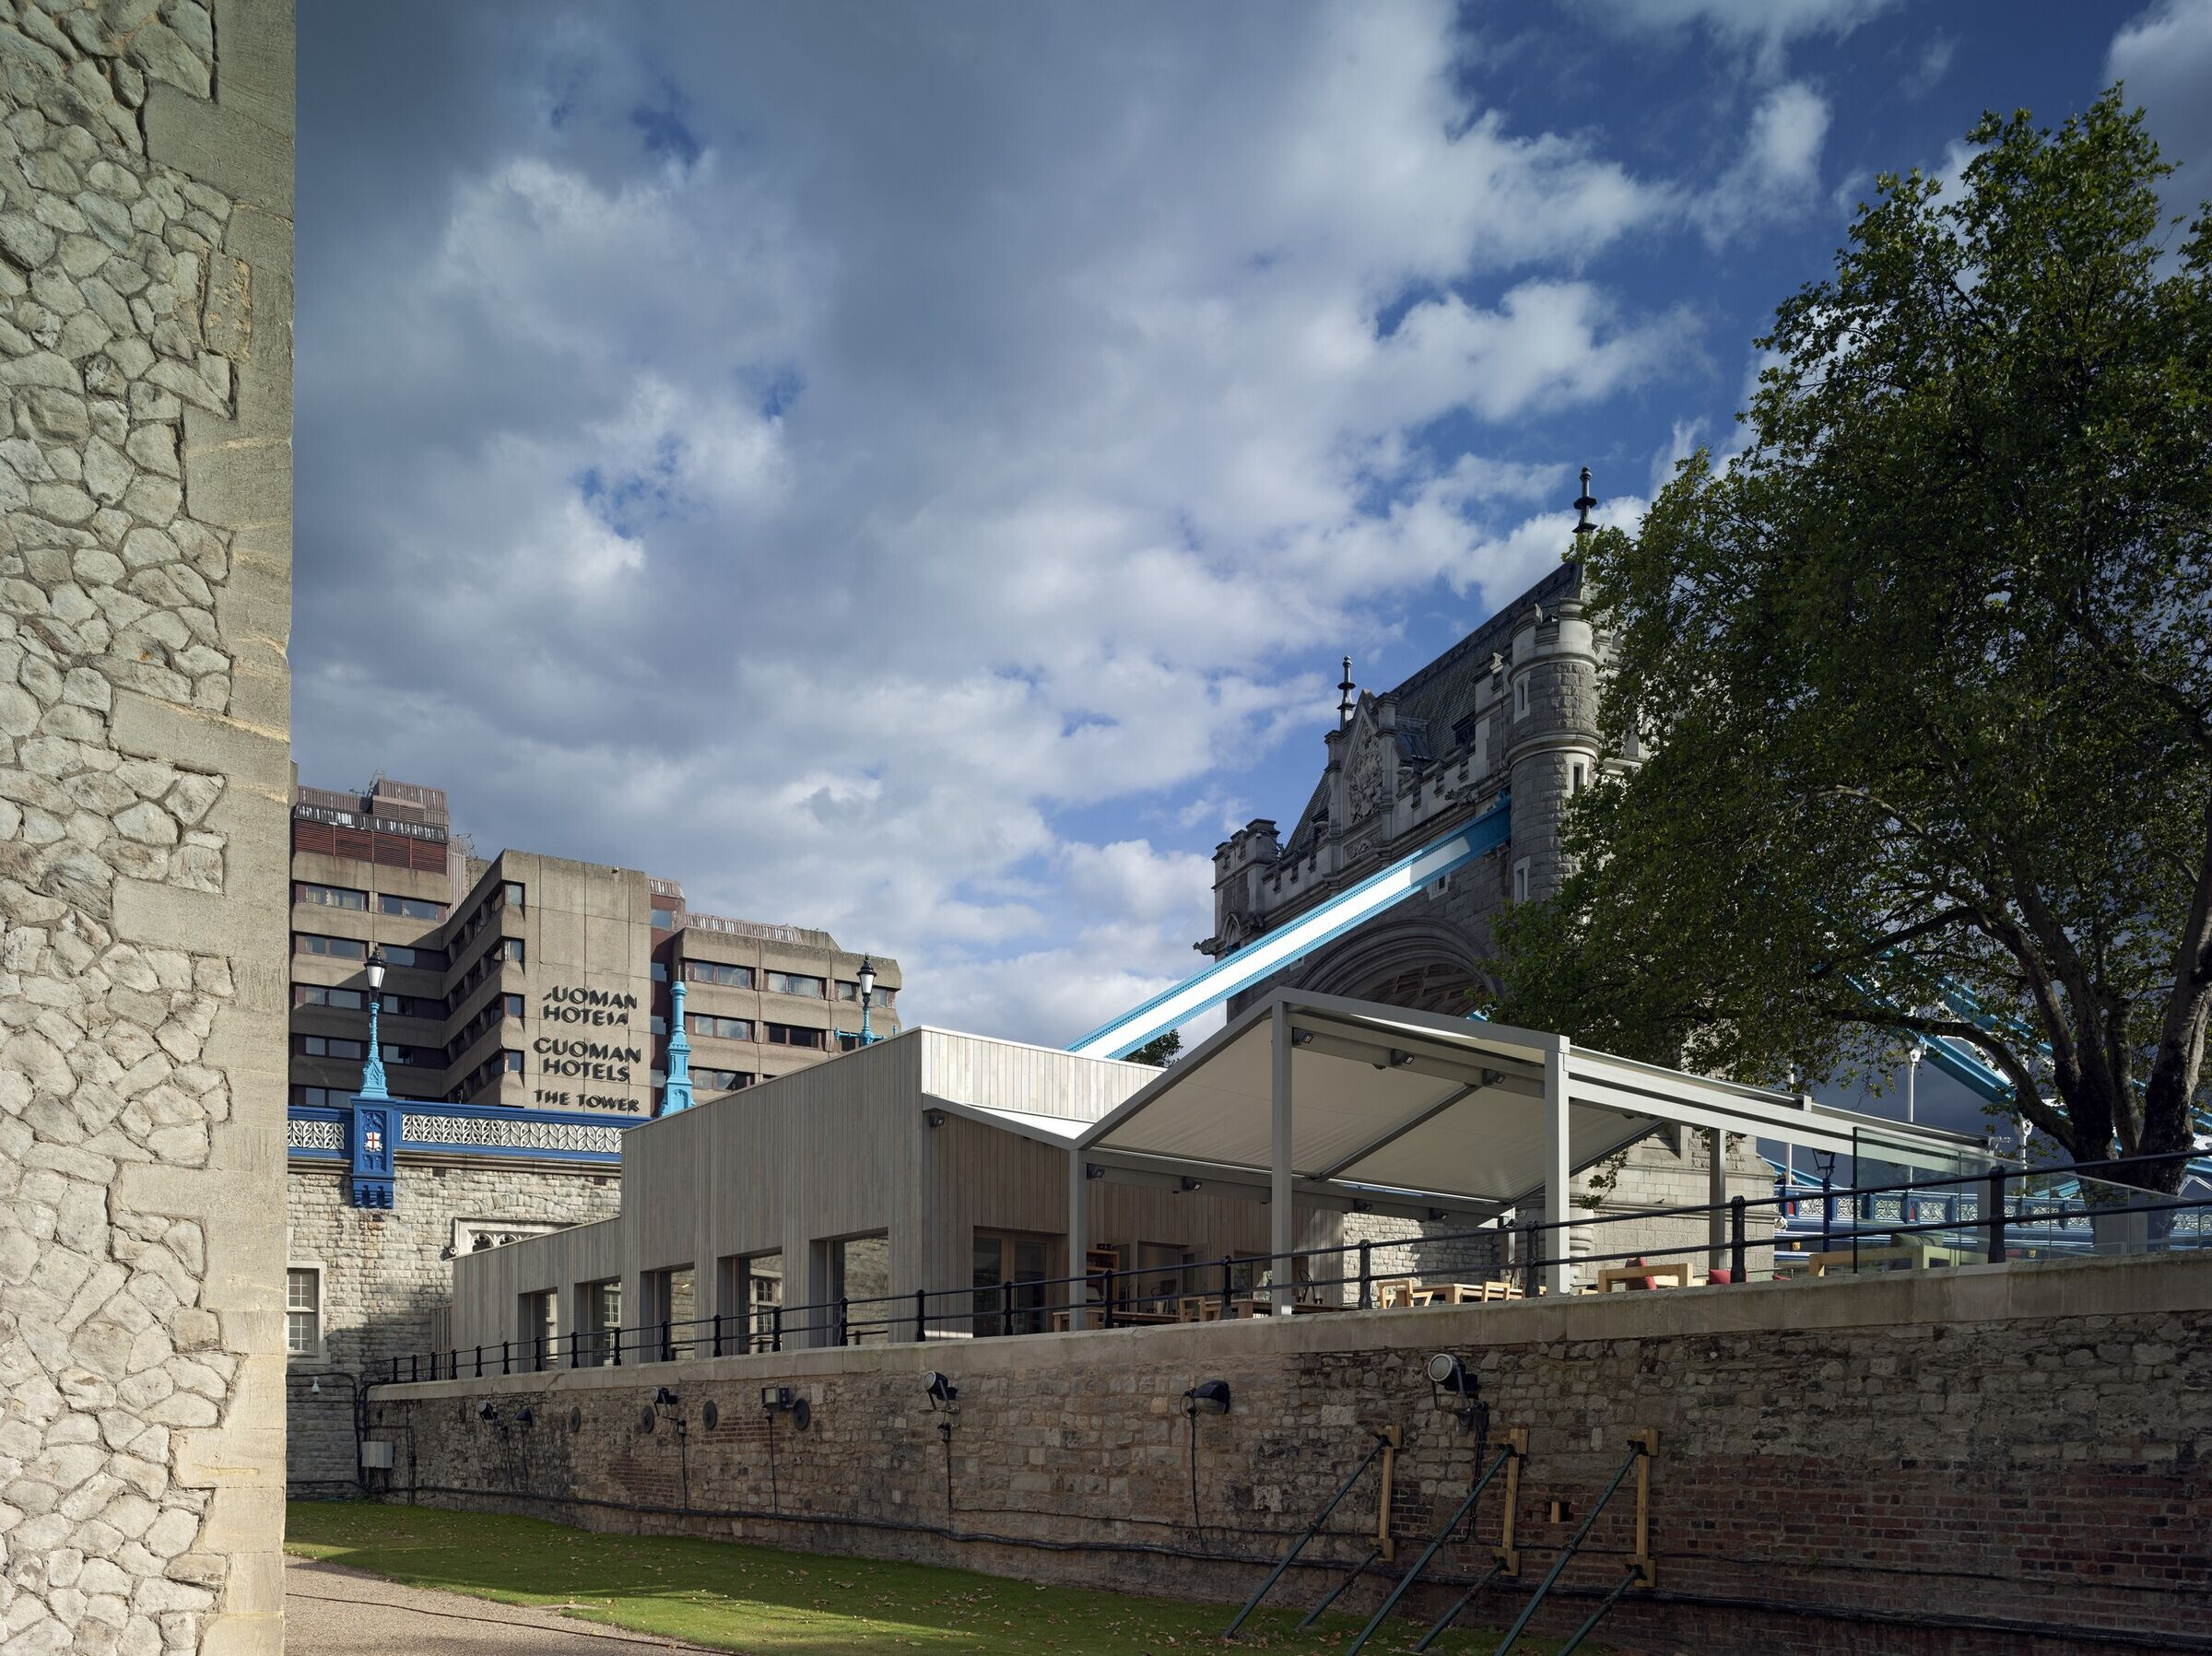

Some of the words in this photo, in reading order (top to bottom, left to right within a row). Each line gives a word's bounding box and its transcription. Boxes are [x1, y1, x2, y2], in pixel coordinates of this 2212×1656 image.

[543, 1058, 630, 1082] HOTELS
[534, 1089, 571, 1105] THE
[576, 1094, 640, 1112] TOWER
